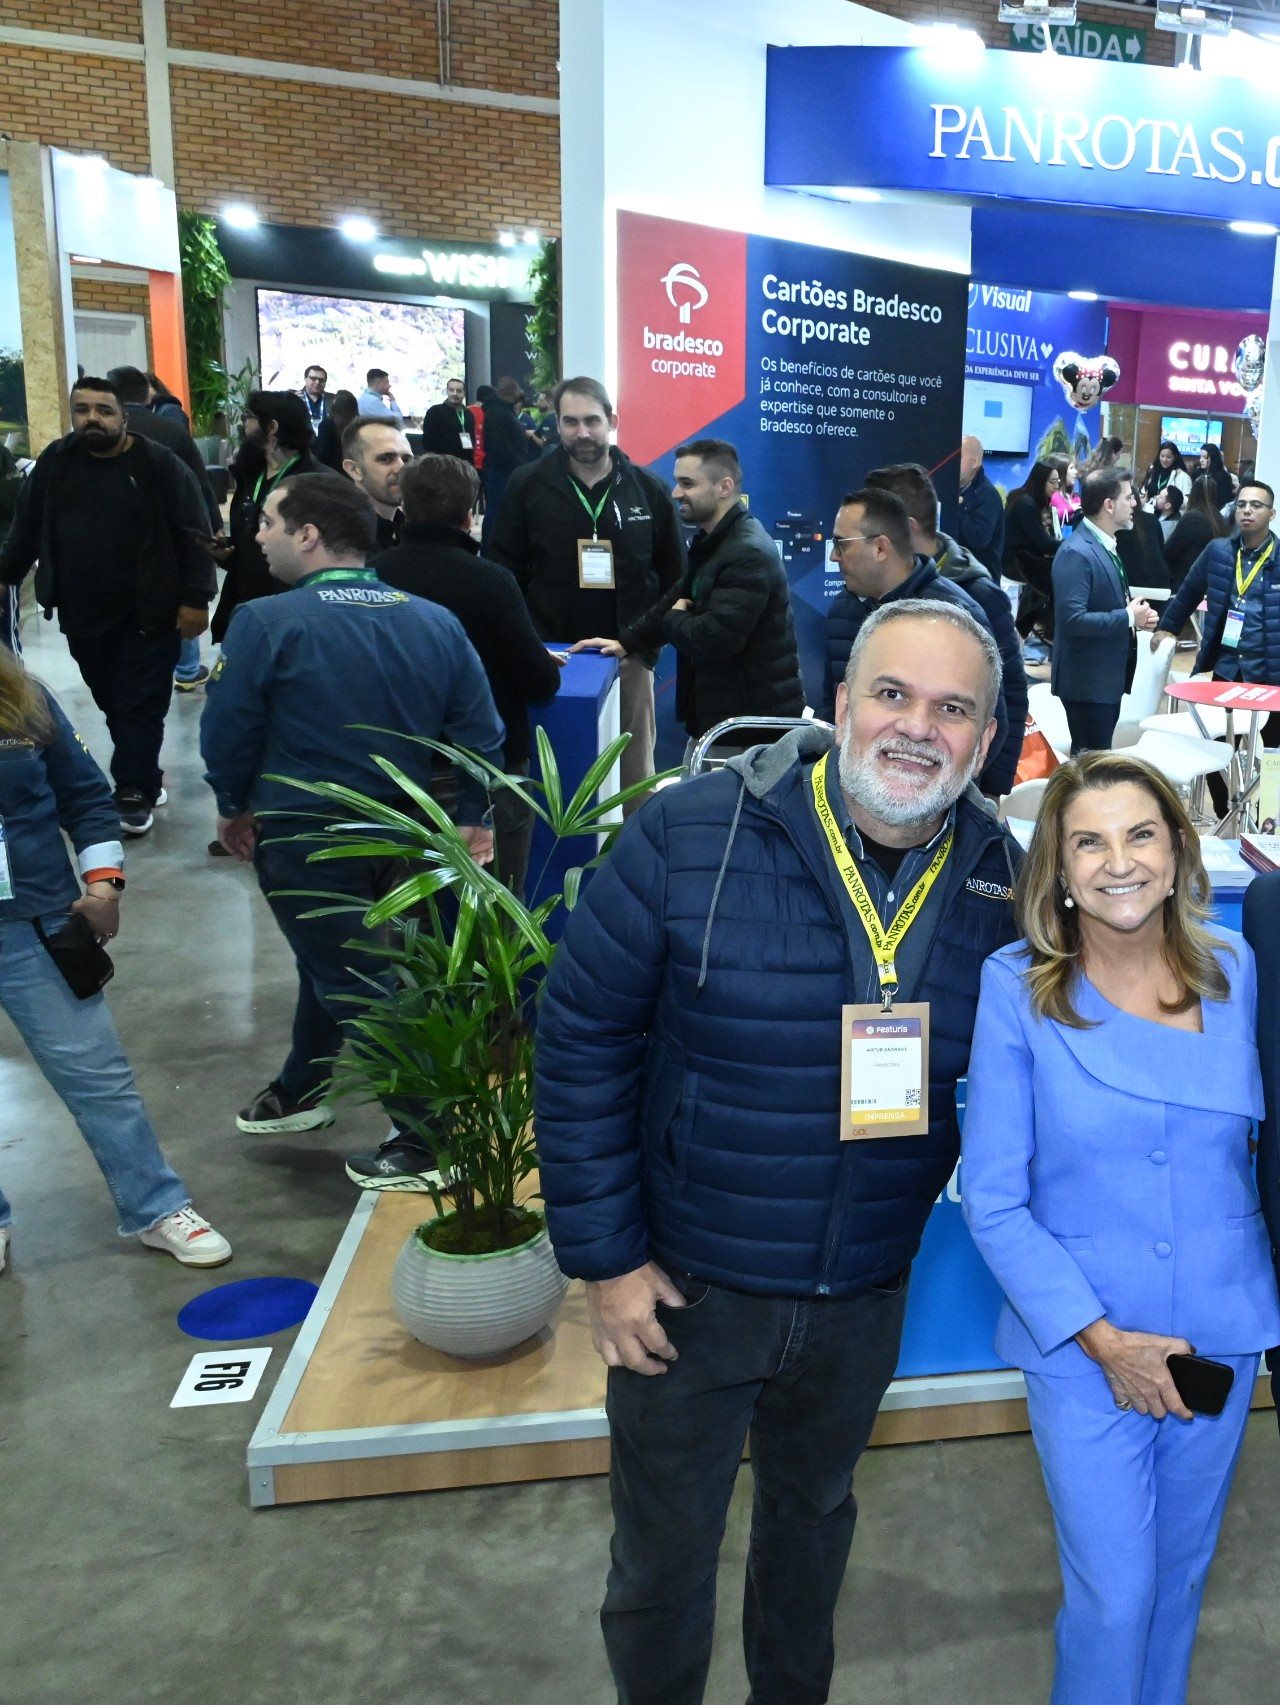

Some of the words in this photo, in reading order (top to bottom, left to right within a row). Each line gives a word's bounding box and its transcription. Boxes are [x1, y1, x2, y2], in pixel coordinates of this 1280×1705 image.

[1031, 21, 1123, 62] SAÍDA
[762, 274, 848, 310] Cartões
[853, 288, 942, 324] Bradesco
[982, 284, 1033, 313] Visual
[643, 326, 724, 357] bradesco
[762, 308, 871, 346] Corporate
[651, 359, 716, 379] corporate
[761, 356, 777, 372] Os
[780, 358, 838, 378] benefícios
[840, 365, 855, 380] de
[857, 369, 896, 384] cartões
[898, 374, 917, 388] que
[919, 375, 943, 389] você
[1169, 341, 1236, 373] CUR
[974, 366, 1013, 379] EXPERIÊNCIA
[1014, 371, 1029, 380] DEVE
[1030, 372, 1040, 381] SER
[760, 376, 771, 394] já
[773, 378, 824, 397] conhece,
[827, 385, 850, 398] com
[853, 388, 860, 399] a
[862, 388, 918, 404] consultoria
[920, 394, 927, 405] e
[760, 399, 814, 415] expertise
[816, 403, 837, 418] que
[840, 404, 886, 420] somente
[888, 410, 895, 421] o
[760, 417, 813, 435] Bradesco
[816, 421, 859, 437] oferece.
[317, 588, 397, 603] PANROTAS
[814, 774, 843, 855] PANROTAS.com.br
[966, 877, 1008, 898] ANROTAS
[843, 865, 883, 949] PANROTAS.com.br
[882, 881, 926, 952] PANROTAS.com.br
[864, 1113, 905, 1121] IMPRENSA
[194, 1361, 252, 1392] F76
